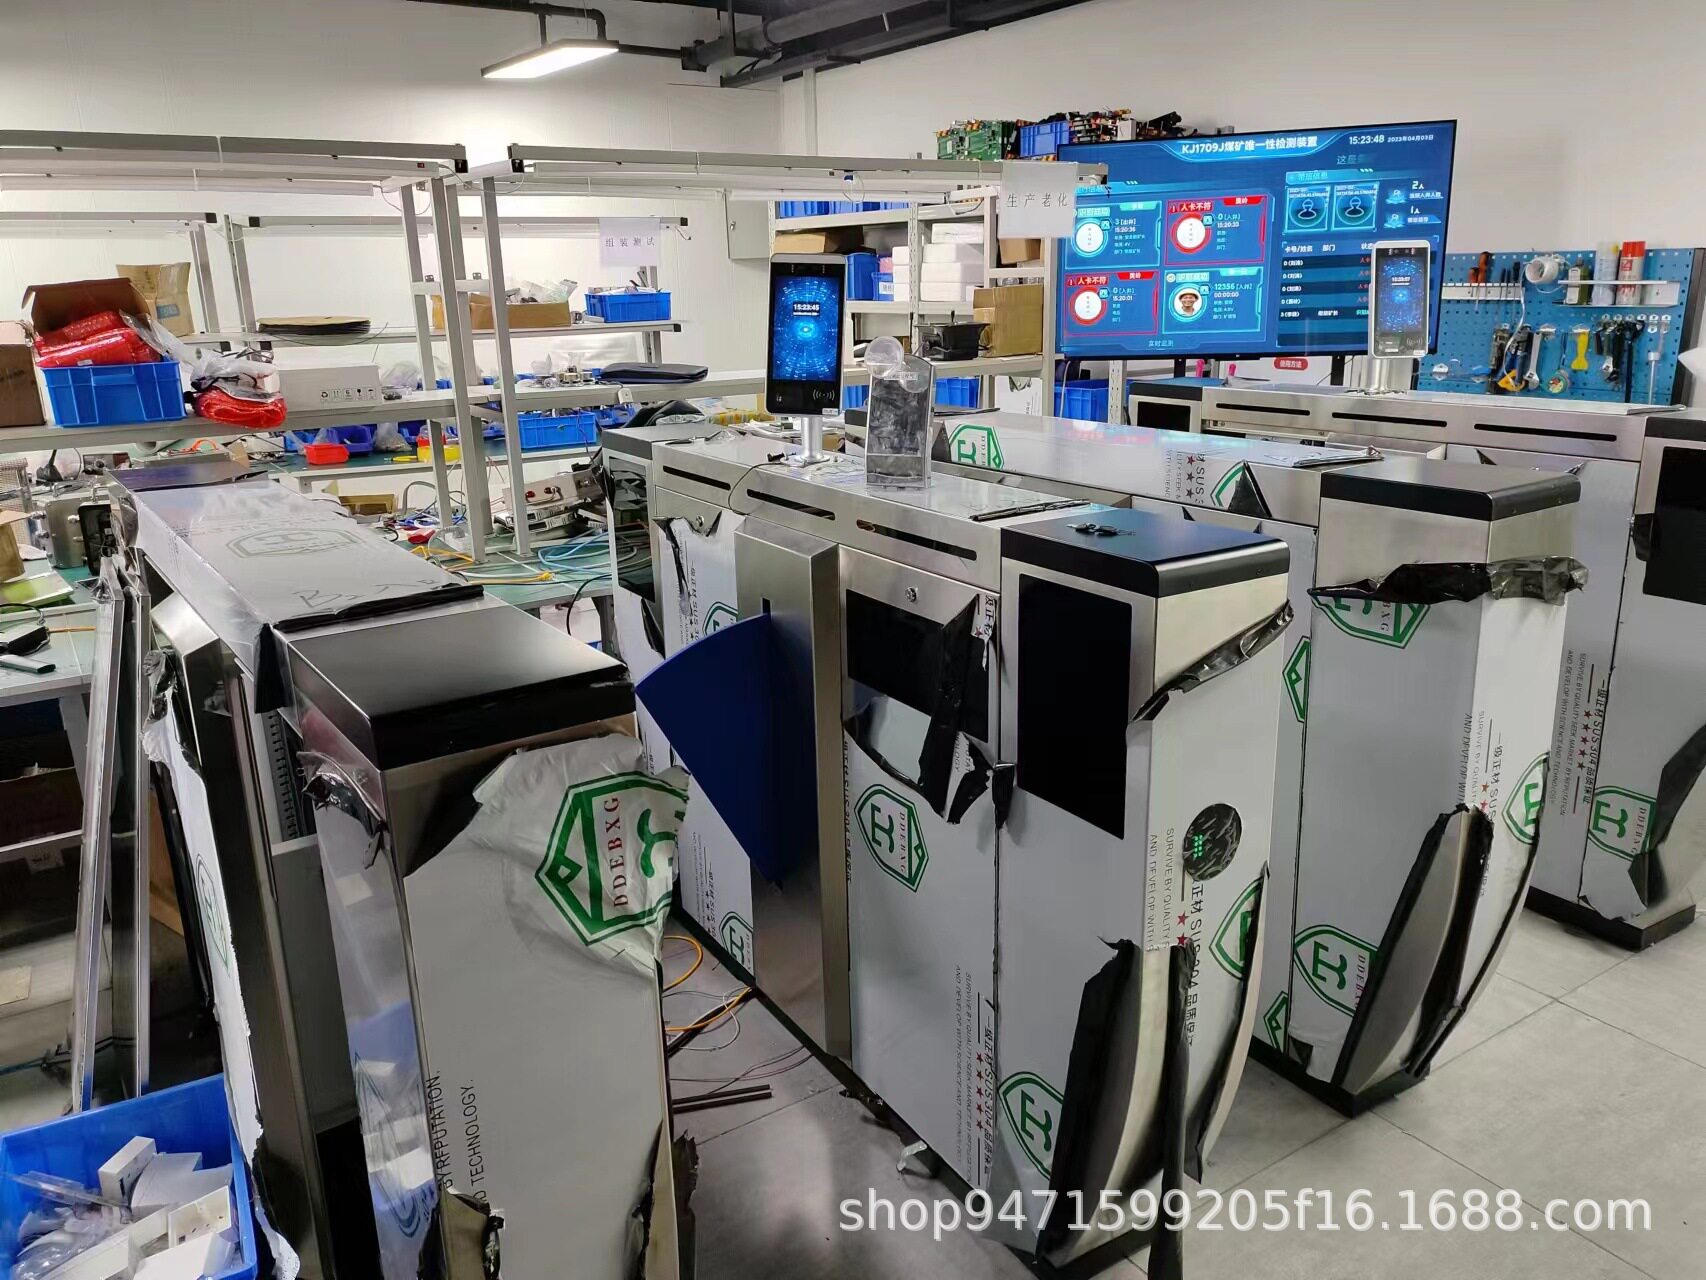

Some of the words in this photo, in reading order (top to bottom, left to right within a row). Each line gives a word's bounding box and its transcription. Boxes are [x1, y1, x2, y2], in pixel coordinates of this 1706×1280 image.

[1182, 136, 1317, 154] KJ1709J煤矿唯一性检测装置
[1350, 135, 1384, 144] 15:23:48
[1007, 193, 1067, 207] 生产老化
[1181, 202, 1211, 211] 人卡不符
[1194, 466, 1206, 495] SUS
[1594, 679, 1608, 718] 一级正材
[1463, 713, 1472, 734] AND
[1591, 720, 1602, 744] SUS
[1491, 732, 1504, 785] 一级正材
[1588, 745, 1599, 765] 304
[604, 797, 628, 908] DDEBXG
[1149, 834, 1158, 856] AND
[1164, 828, 1174, 876] SURVIVE
[1164, 878, 1172, 891] BY
[1162, 895, 1172, 940] QUALITY
[984, 1068, 992, 1098] SUS
